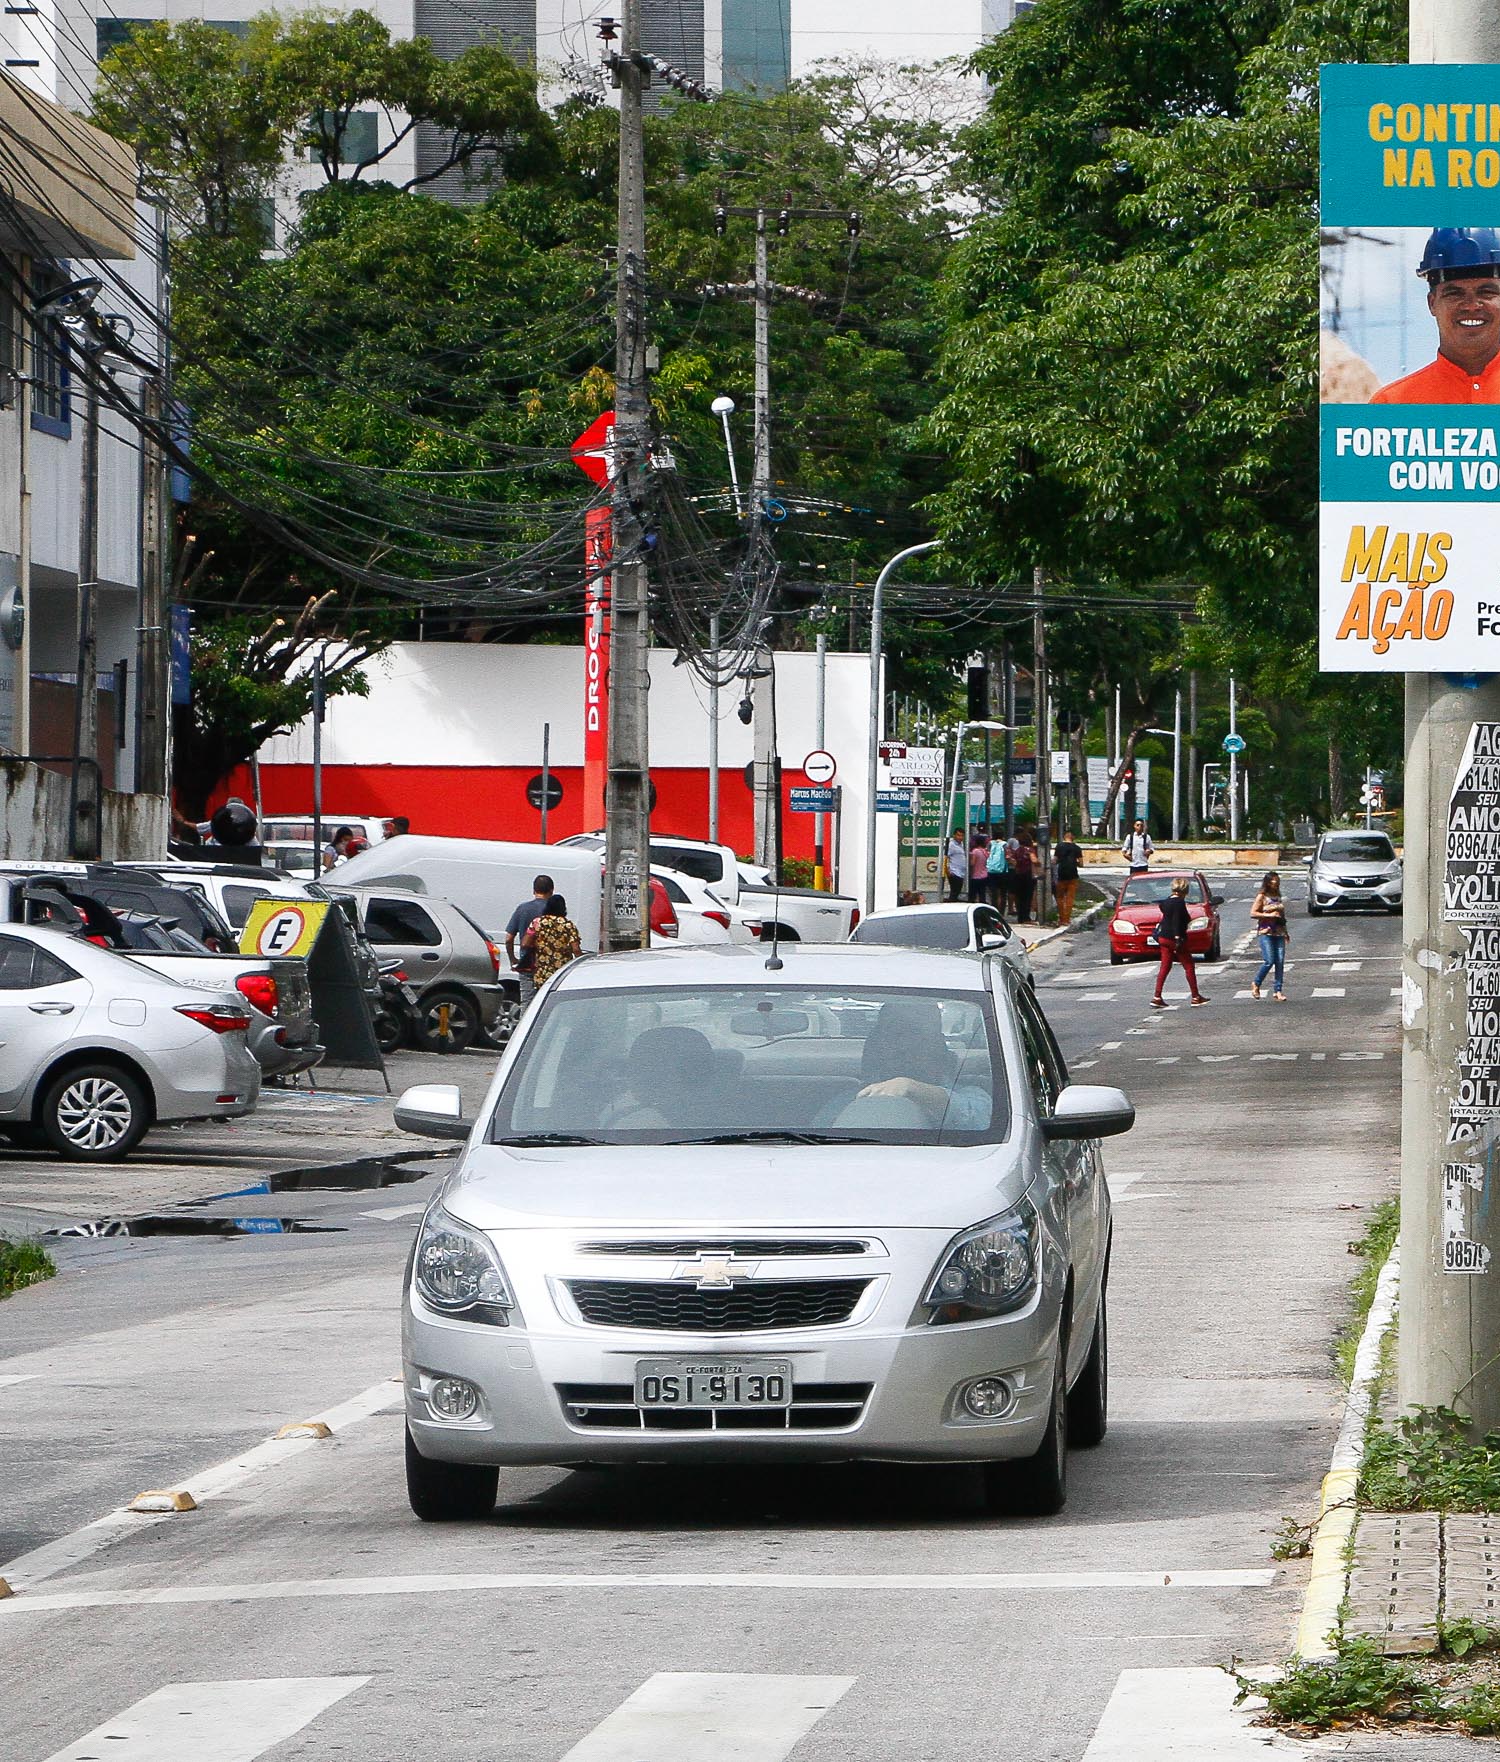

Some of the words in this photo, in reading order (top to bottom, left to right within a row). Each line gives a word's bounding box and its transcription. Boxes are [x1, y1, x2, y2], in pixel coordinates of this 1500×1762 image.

[1383, 149, 1436, 188] NA
[1336, 428, 1498, 457] FORTALEZA
[1389, 461, 1454, 490] COM
[890, 762, 935, 771] CARLOS
[919, 777, 942, 786] 3333
[790, 789, 810, 798] Marcos
[1476, 794, 1498, 806] SEU
[15, 863, 81, 872] DUSTER
[1476, 862, 1496, 874] DE
[615, 888, 638, 897] AMOR
[614, 907, 637, 916] VOLTA
[268, 919, 293, 950] E
[1470, 998, 1494, 1011] SEU
[1470, 1066, 1491, 1079] DE
